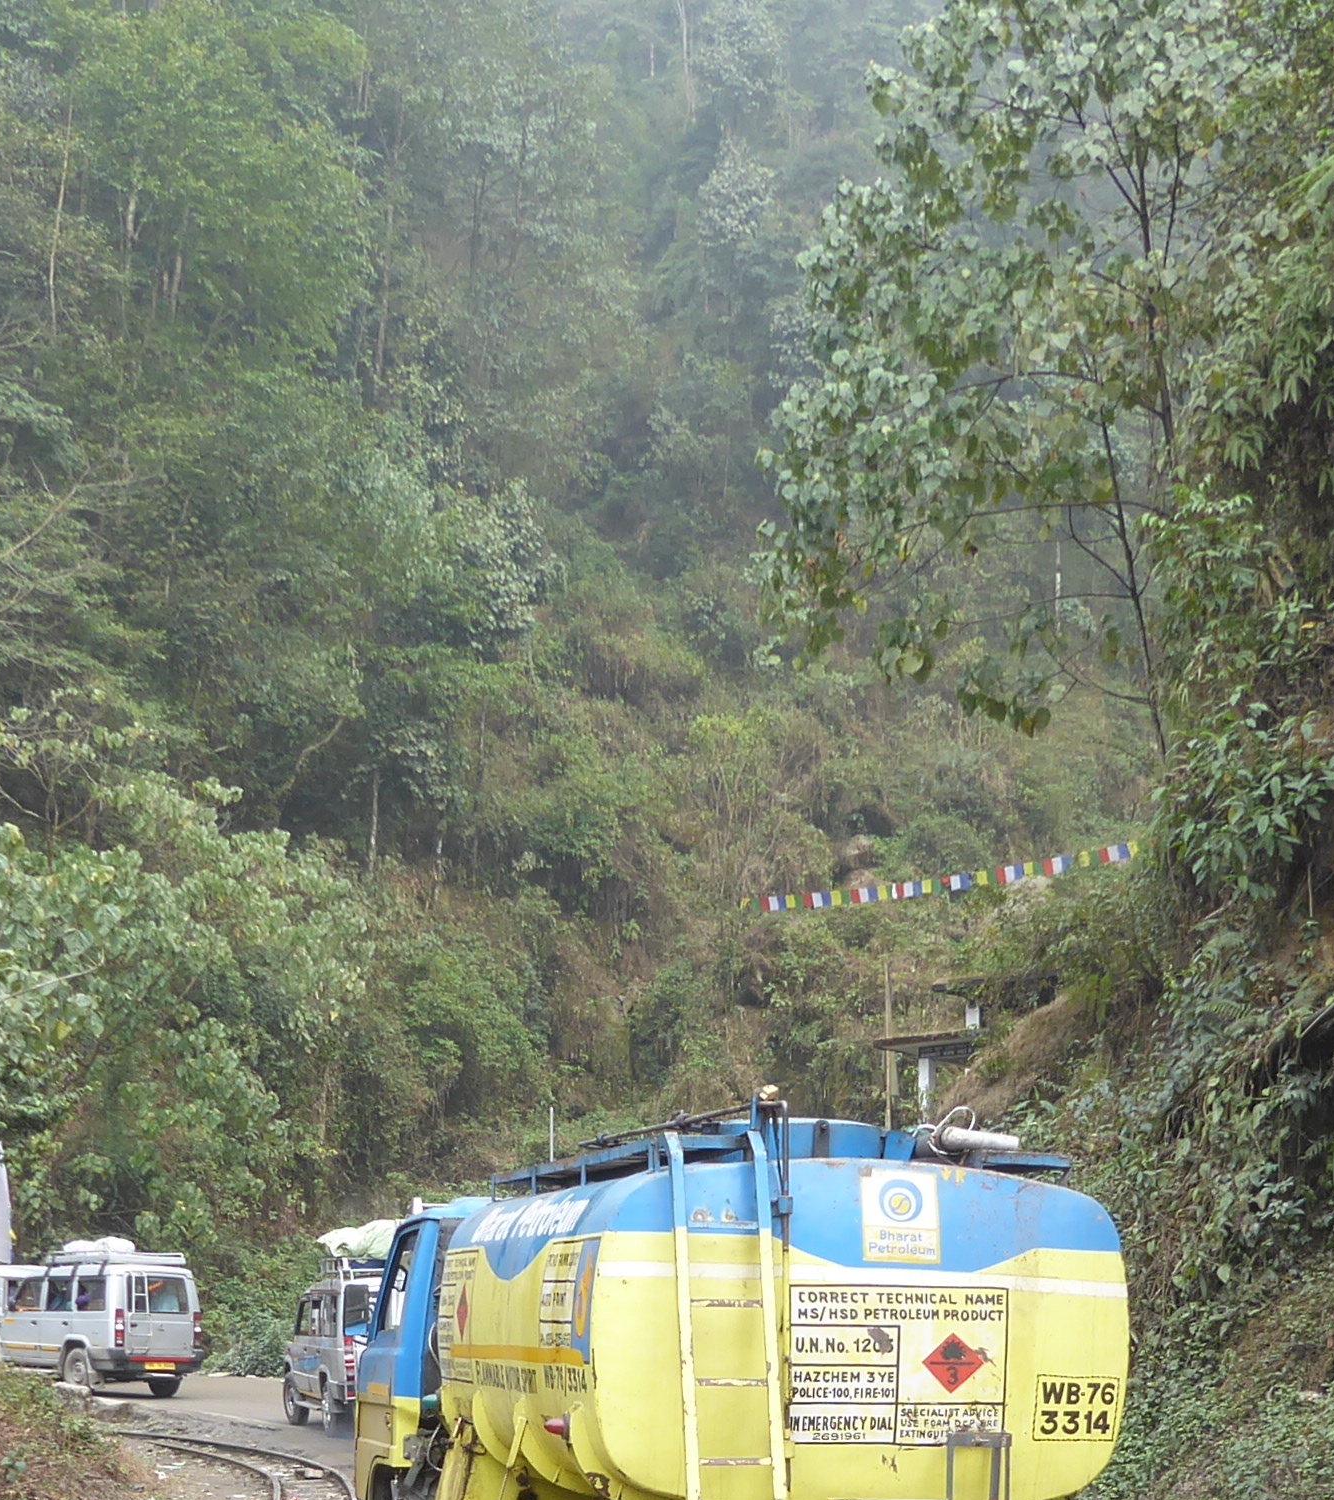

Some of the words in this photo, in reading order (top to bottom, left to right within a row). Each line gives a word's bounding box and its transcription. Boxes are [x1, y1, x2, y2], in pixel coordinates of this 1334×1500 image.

[471, 1205, 522, 1243] Bharat
[510, 1193, 590, 1238] Petroleum
[880, 1229, 923, 1242] Bharat
[868, 1241, 936, 1256] Petroleum
[798, 1291, 869, 1305] CORRECT
[876, 1292, 957, 1306] TECHNICAL
[964, 1293, 1004, 1306] NAME
[797, 1306, 859, 1322] MS/HSD
[864, 1308, 940, 1321] PETROLEUM
[943, 1309, 1004, 1322] PRODUCT
[794, 1371, 861, 1384] HAZCHEM
[946, 1366, 959, 1386] 3
[1041, 1381, 1116, 1406] WB-76
[802, 1415, 867, 1432] EMERGENCY
[869, 1416, 894, 1431] DIAL
[1039, 1410, 1111, 1436] 3314
[812, 1432, 867, 1441] 2691961
